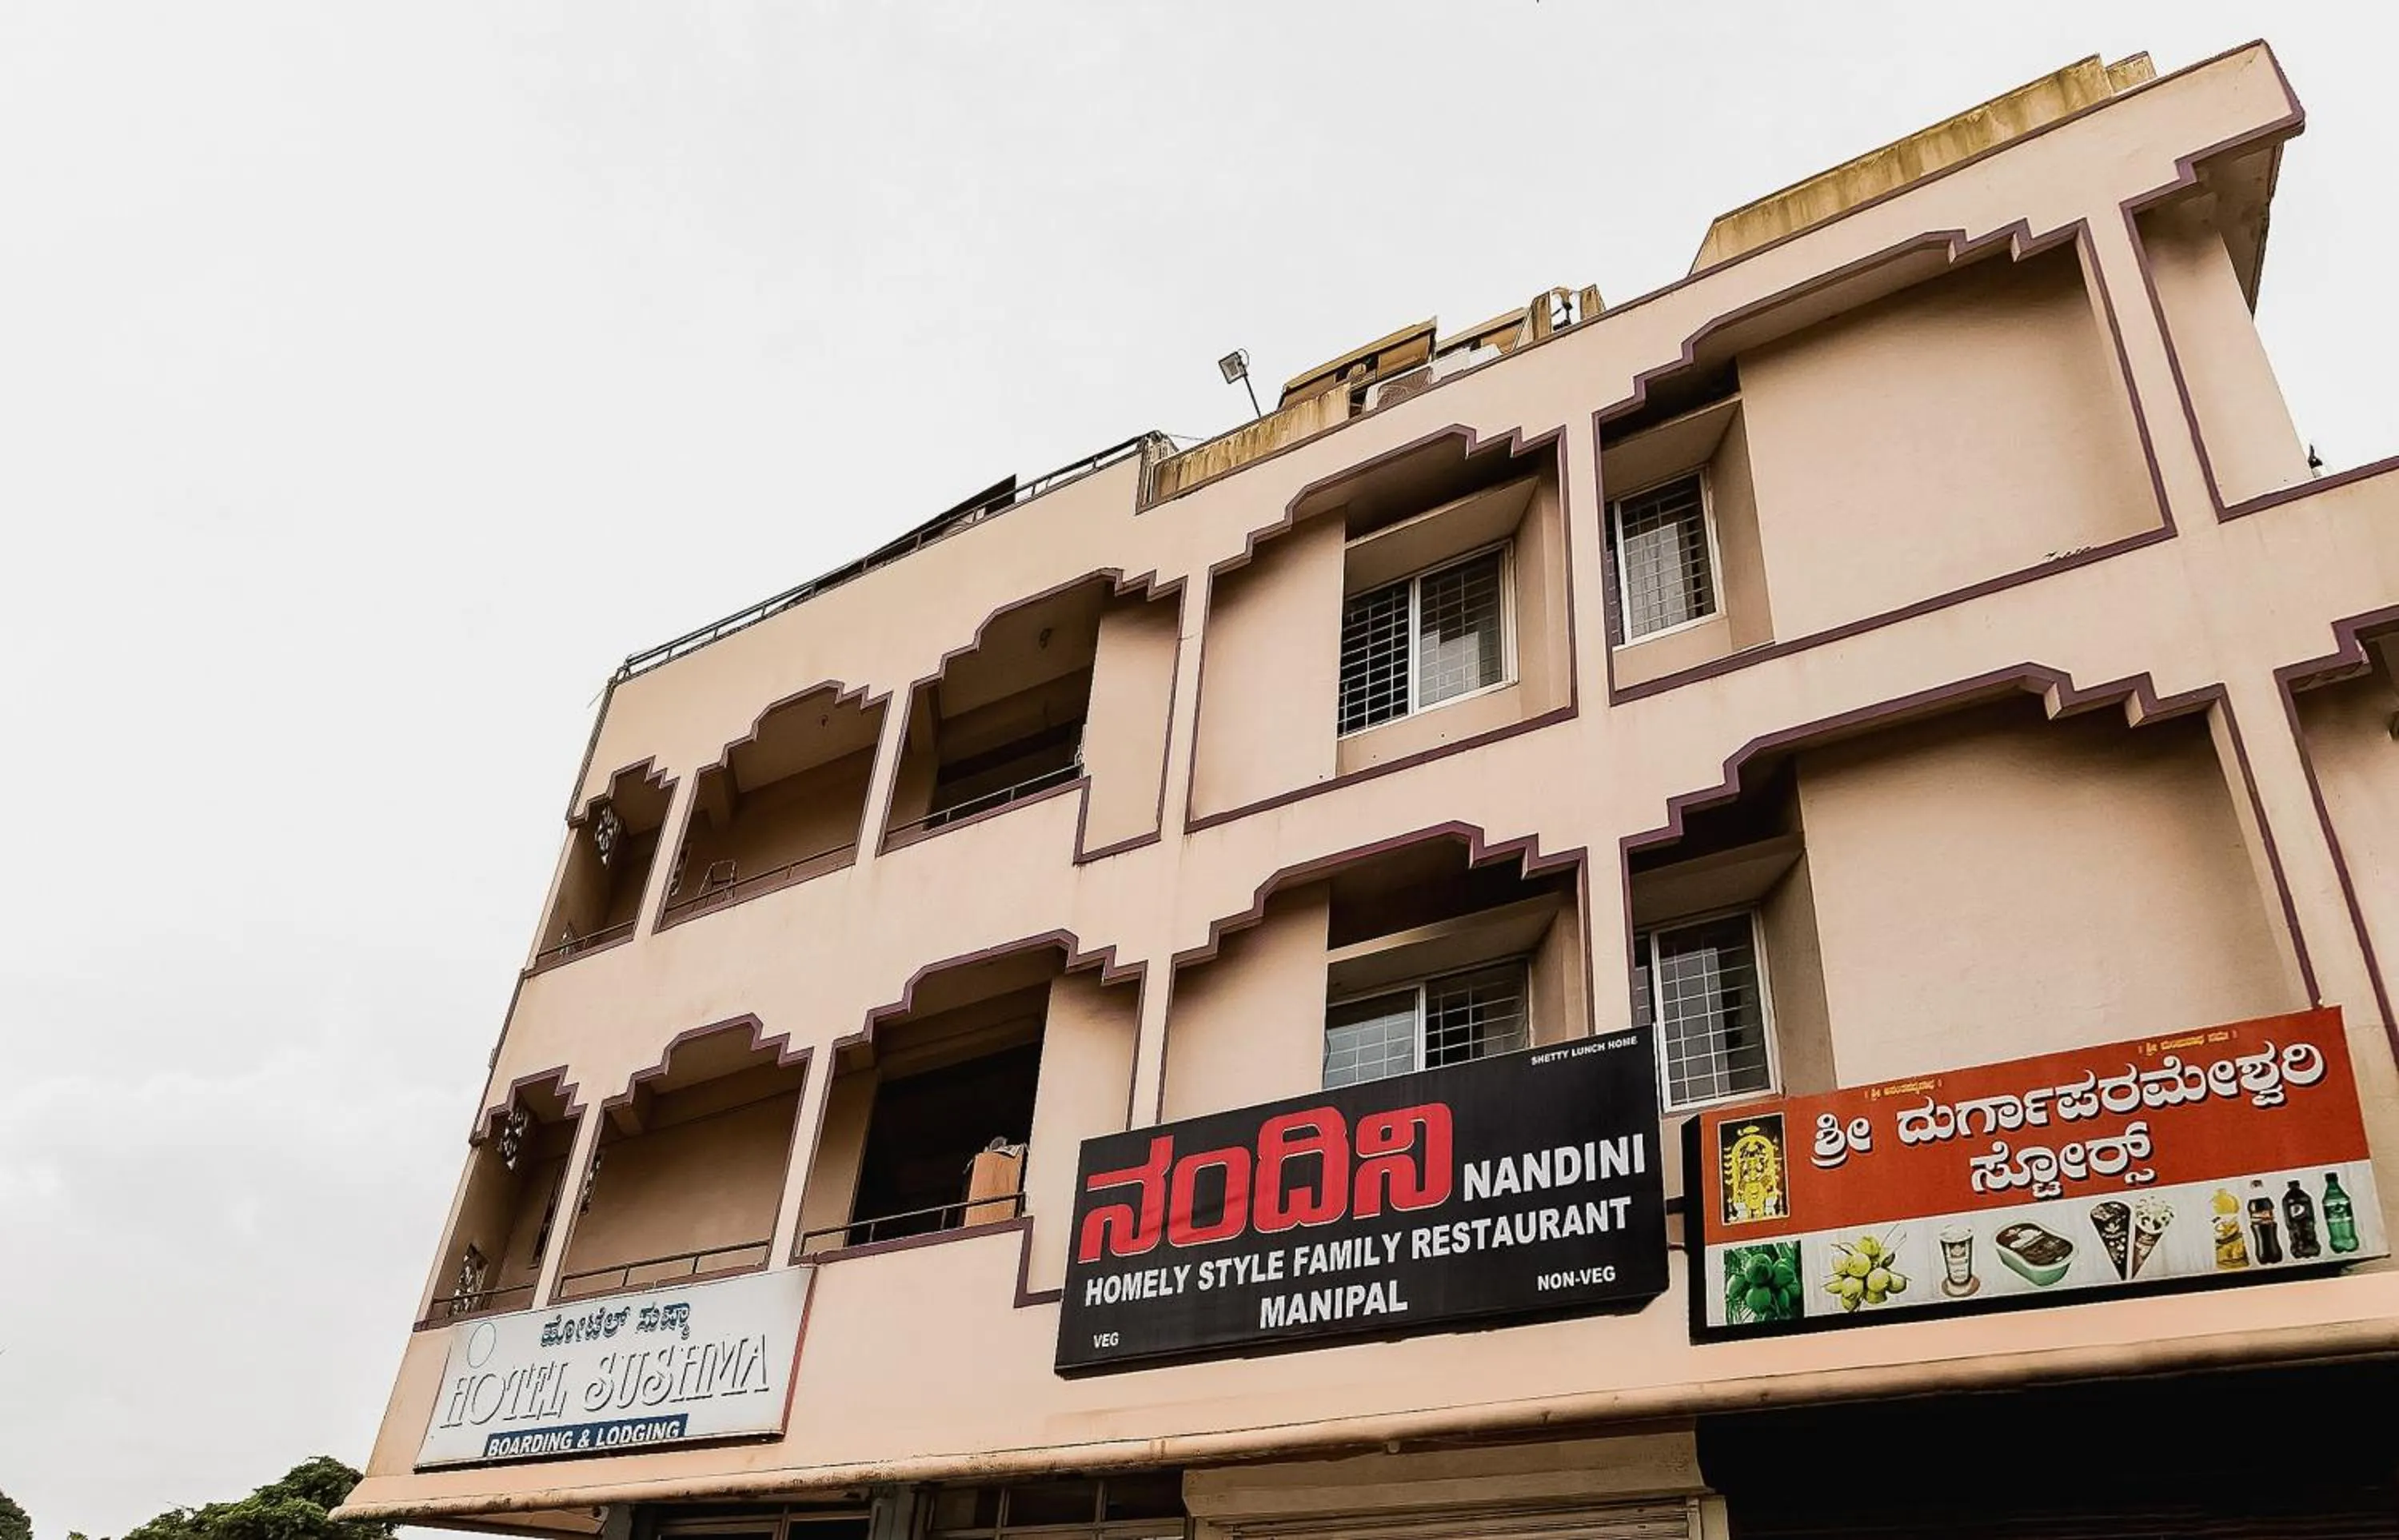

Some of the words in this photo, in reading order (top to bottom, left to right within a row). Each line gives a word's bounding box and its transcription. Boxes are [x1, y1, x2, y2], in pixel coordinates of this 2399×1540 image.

[1531, 1050, 1569, 1066] SHETTY
[1571, 1042, 1606, 1058] LUNCH
[1608, 1035, 1639, 1049] HOME
[1810, 1112, 1872, 1168] ಶ್ರೀ
[1895, 1039, 2325, 1145] ದುರ್ಗಾಪರಮೇಶ್ವರಿ
[1077, 1102, 1453, 1264] ನಂದಿನಿ
[1463, 1133, 1646, 1202] NANDINI
[1084, 1264, 1192, 1307] HOMELY
[1197, 1251, 1285, 1291] STYLE
[1293, 1231, 1402, 1277] FAMILY
[1411, 1195, 1632, 1260] RESTAURANT
[1537, 1266, 1617, 1291] NON-VEG
[541, 1306, 630, 1347] ಹೋಟೆಲ್
[1259, 1279, 1409, 1330] MANIPAL
[1092, 1331, 1120, 1349] VEG
[439, 1361, 569, 1429] HOTEL
[584, 1333, 770, 1412] SUSHMA
[487, 1431, 573, 1458] BOARDING
[577, 1428, 591, 1449] &
[597, 1420, 681, 1447] LODGING
